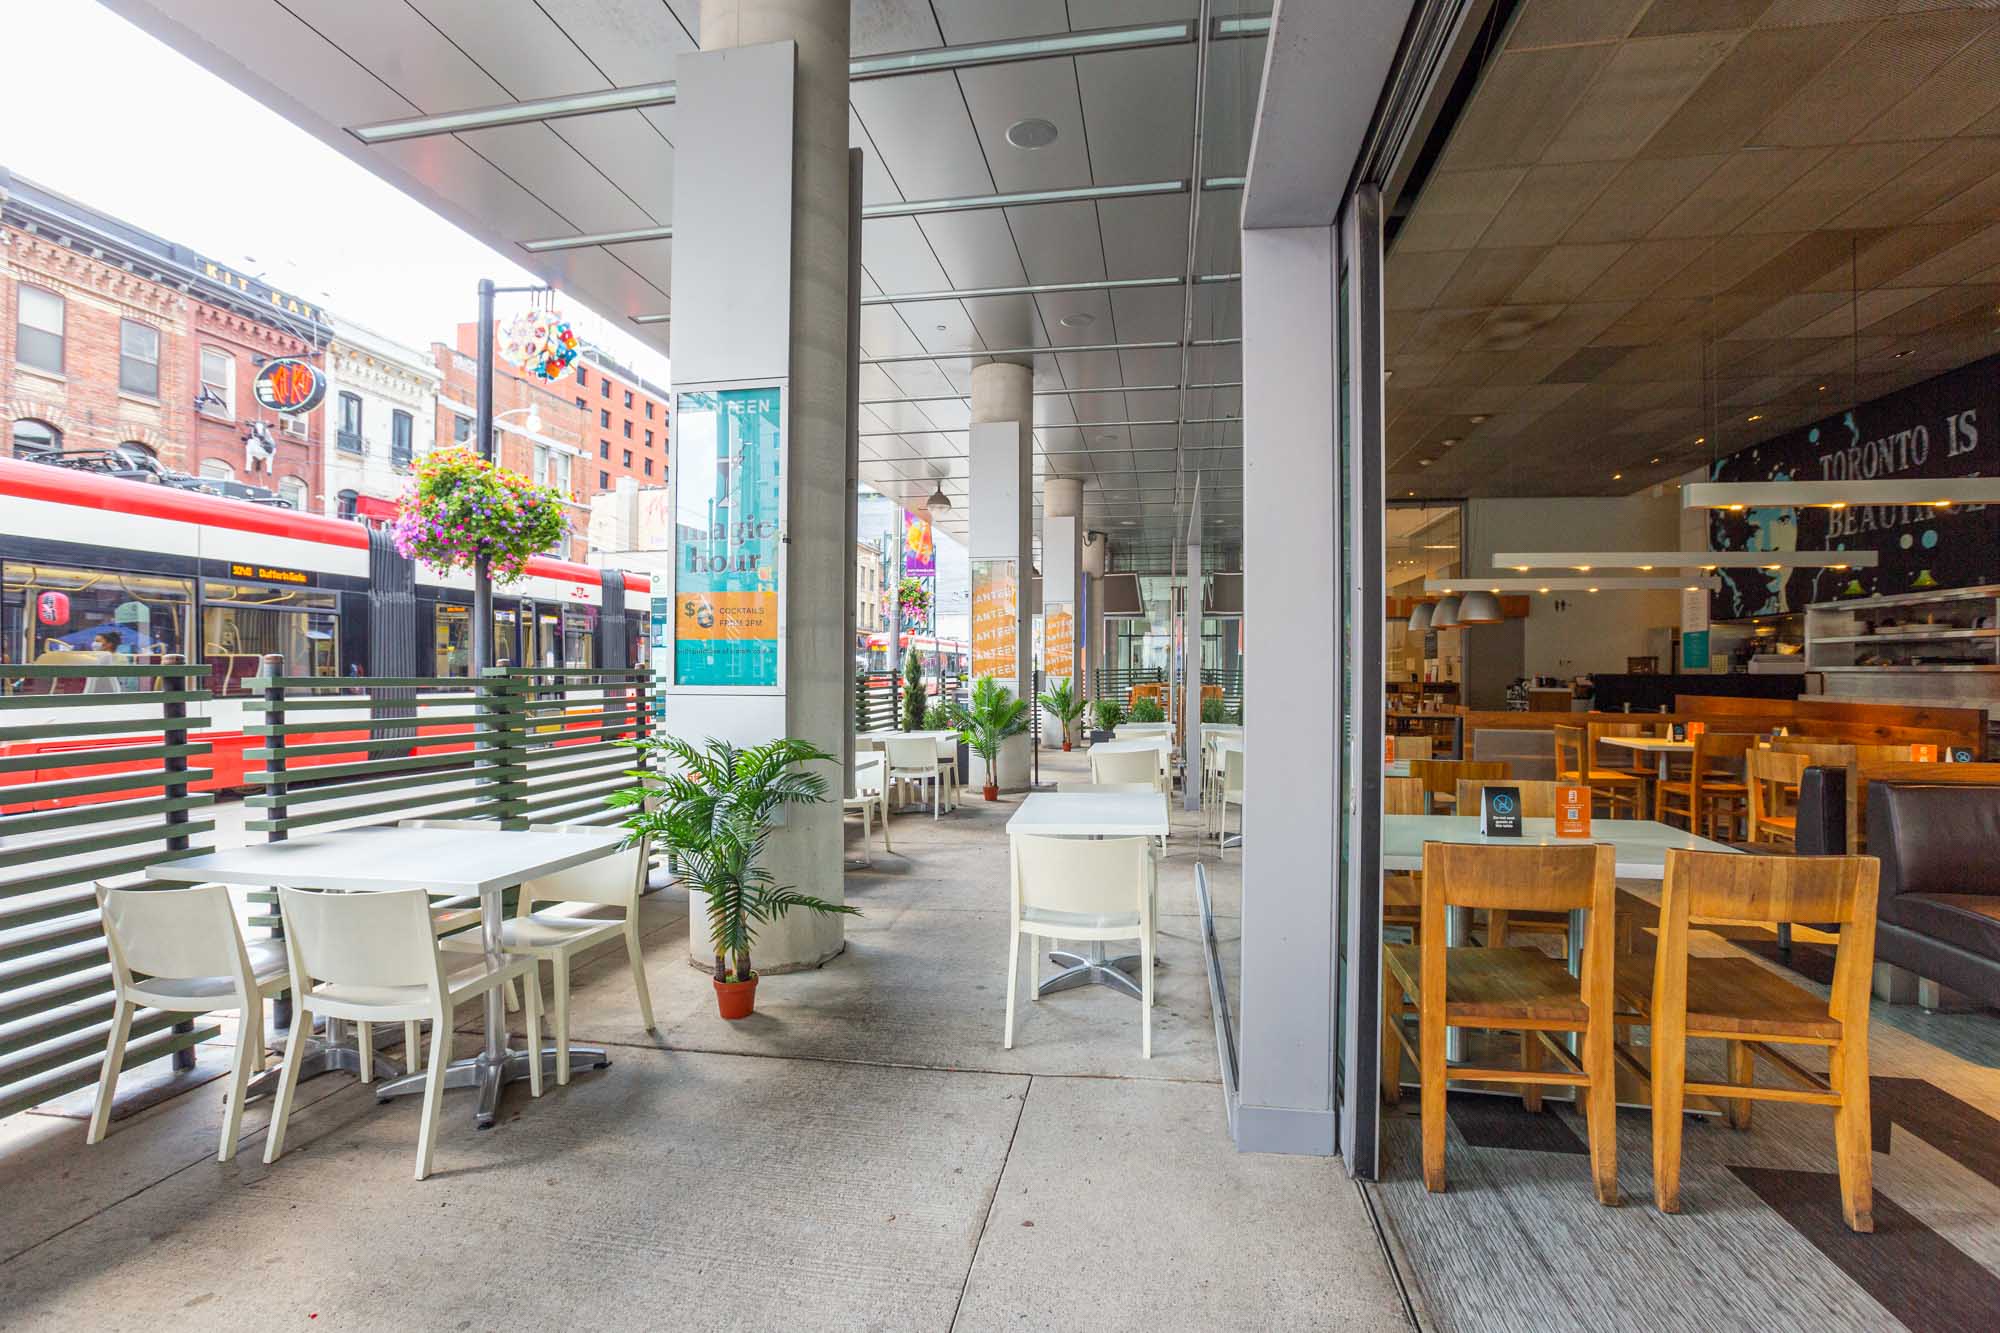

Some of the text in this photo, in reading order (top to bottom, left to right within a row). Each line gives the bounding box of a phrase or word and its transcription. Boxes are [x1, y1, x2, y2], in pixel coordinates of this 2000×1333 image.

[206, 263, 312, 319] KIT KAT
[1819, 408, 1979, 481] TORONTO IS
[689, 546, 761, 573] hour
[719, 607, 765, 615] COCKTAILS
